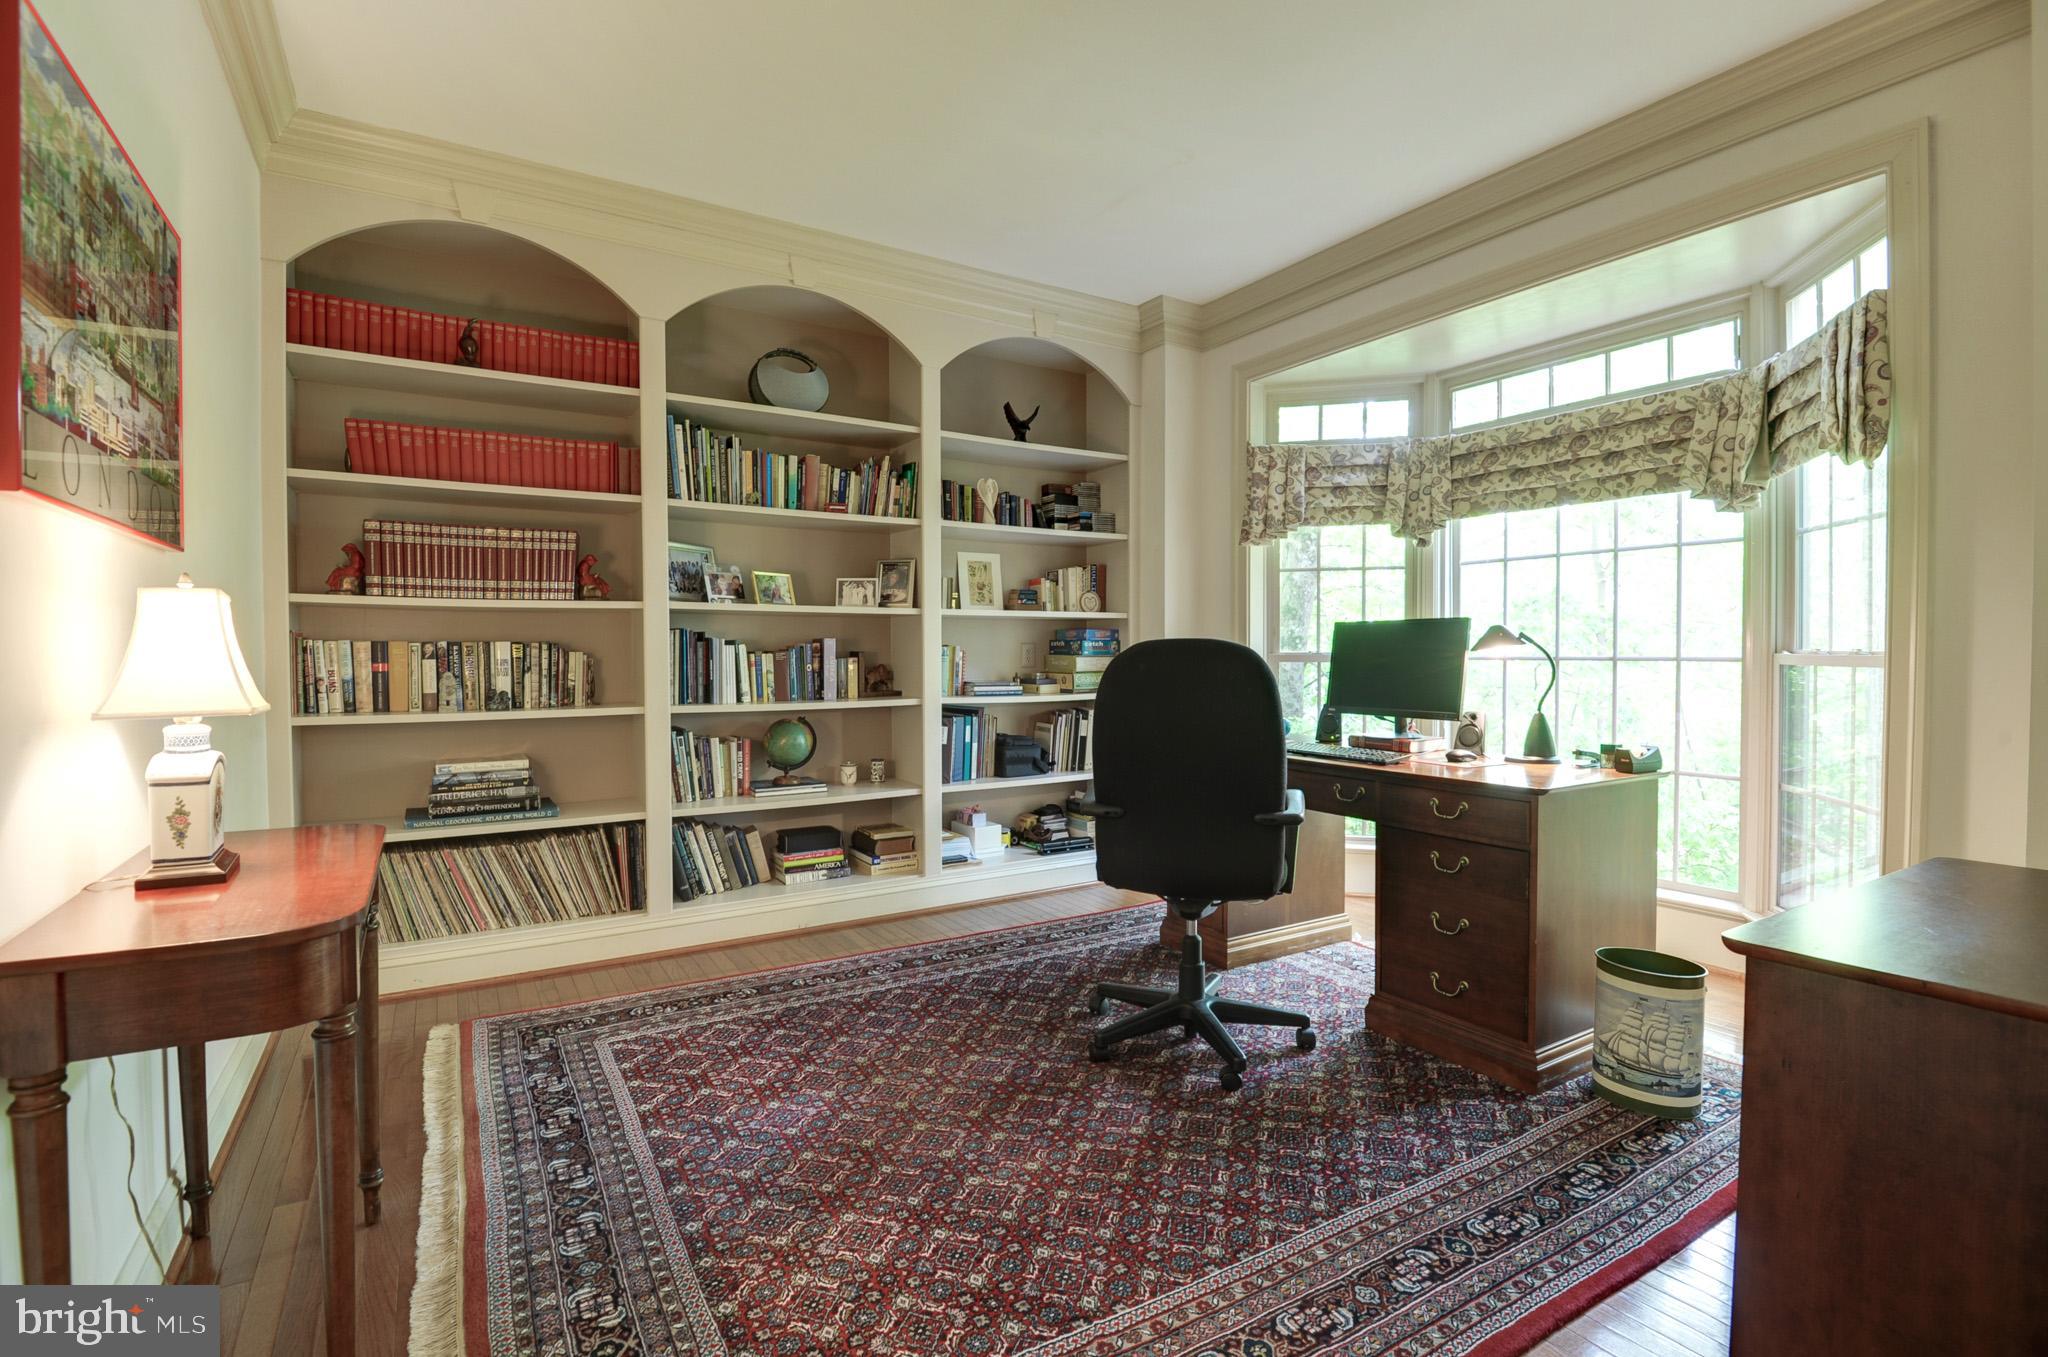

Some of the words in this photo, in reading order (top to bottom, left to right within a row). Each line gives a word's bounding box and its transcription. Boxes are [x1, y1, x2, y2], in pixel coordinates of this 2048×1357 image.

[328, 670, 337, 693] BUMS
[436, 789, 488, 801] FREDERICK
[490, 788, 513, 796] HART
[413, 820, 444, 828] NATIONAL
[445, 817, 481, 825] GEOGRAPHIC
[814, 862, 841, 870] AMERICA
